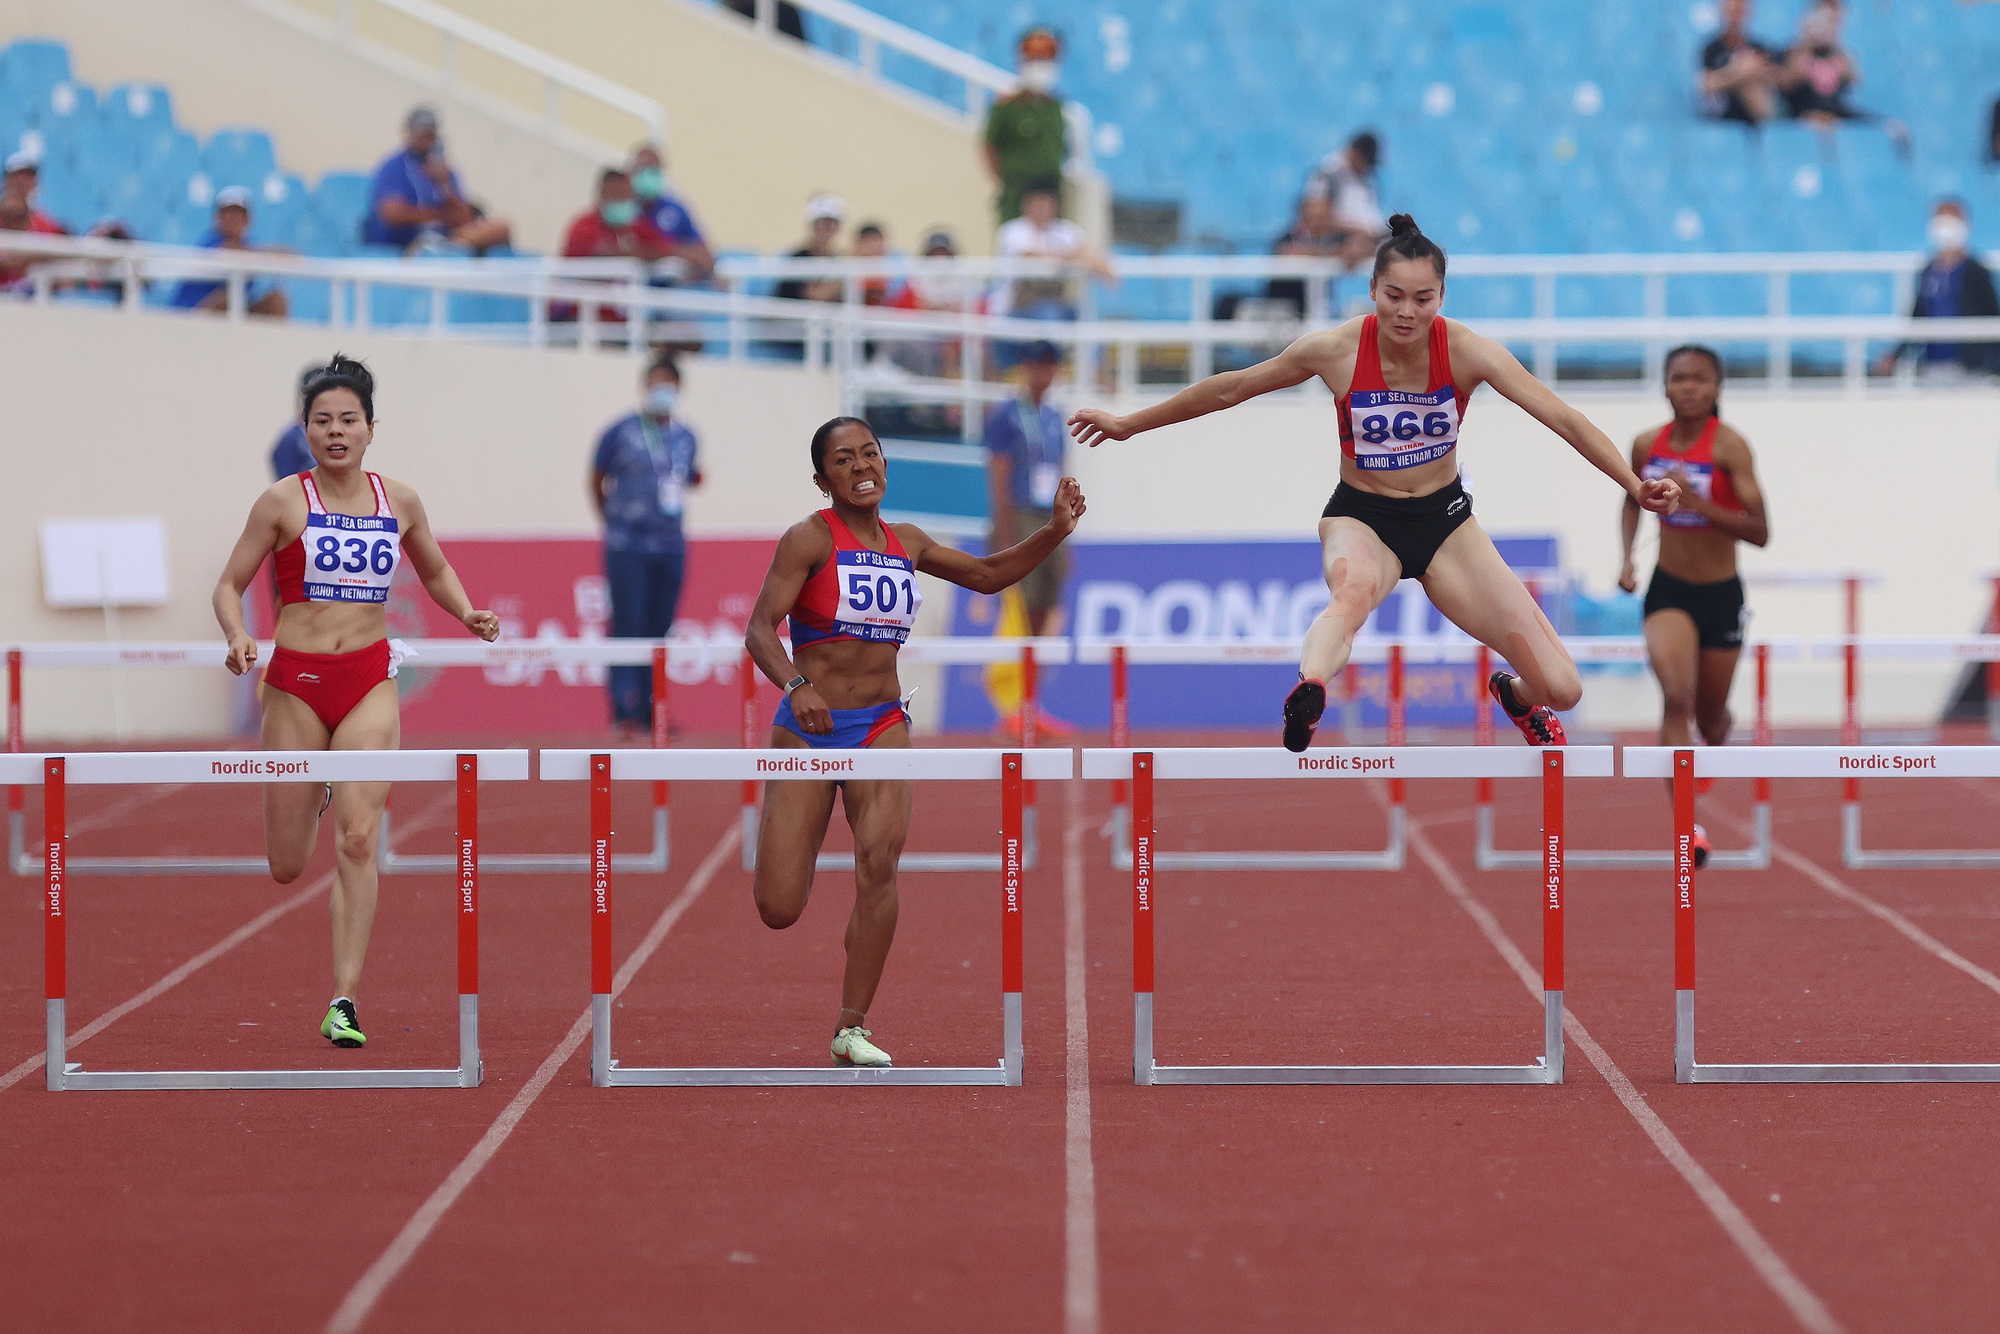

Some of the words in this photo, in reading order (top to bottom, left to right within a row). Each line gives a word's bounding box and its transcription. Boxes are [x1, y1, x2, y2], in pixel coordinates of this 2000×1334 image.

[1388, 392, 1406, 402] SEA
[1407, 395, 1438, 404] Games
[1362, 411, 1451, 444] 866
[1392, 442, 1425, 452] VIETNAM
[1364, 457, 1389, 469] HANOI
[1396, 449, 1433, 467] VIETNAM
[341, 516, 355, 529] SEA
[357, 517, 384, 529] Games
[314, 535, 394, 576] 836
[871, 553, 883, 566] SEA
[883, 556, 905, 568] Games
[309, 585, 334, 597] HANOI
[341, 587, 373, 600] VIETNAM
[848, 573, 914, 615] 501
[864, 617, 902, 625] PHILIPPINES
[870, 627, 897, 640] VIETNAM
[265, 760, 309, 777] Sport
[810, 758, 854, 775] Sport
[1351, 756, 1395, 774] Sport
[1893, 755, 1937, 773] Sport
[48, 883, 62, 917] Sport
[461, 879, 474, 913] Sport
[594, 879, 607, 914] Sport
[1005, 879, 1018, 913] Sport
[1136, 877, 1150, 911] Sport
[1547, 876, 1560, 910] Sport
[1678, 875, 1691, 909] Sport
